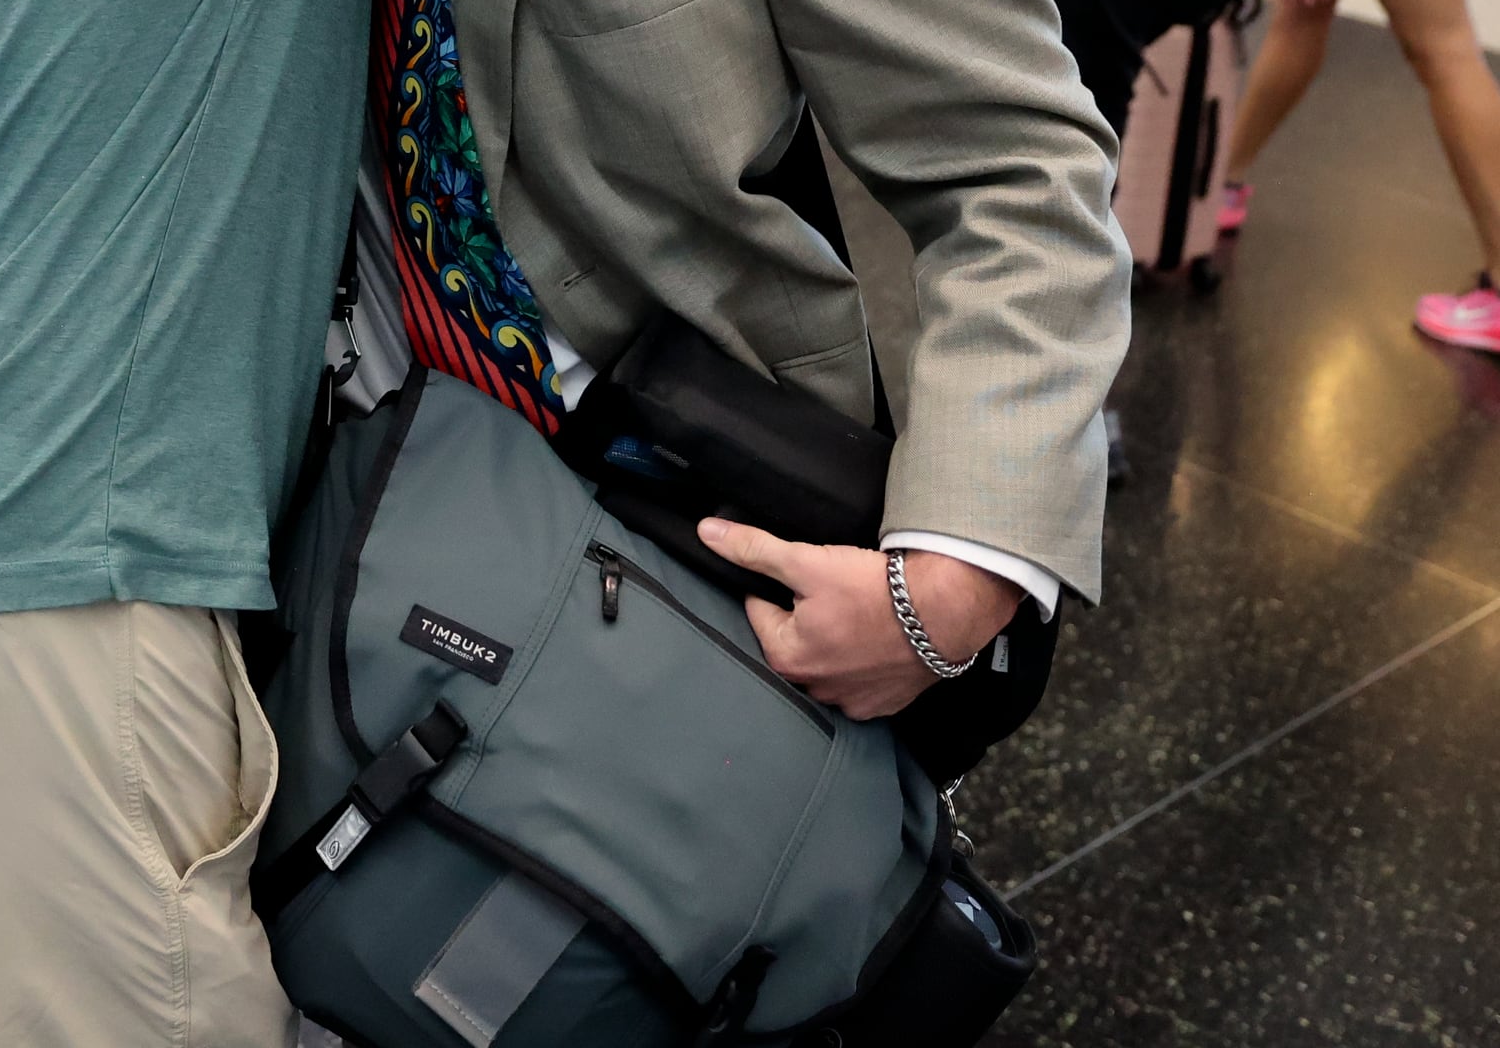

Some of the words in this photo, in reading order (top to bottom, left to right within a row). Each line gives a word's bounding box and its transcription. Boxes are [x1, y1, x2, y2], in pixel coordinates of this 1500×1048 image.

[421, 618, 497, 664] TIMBUK2
[432, 638, 444, 648] SAN
[444, 643, 475, 662] FRANCISCO
